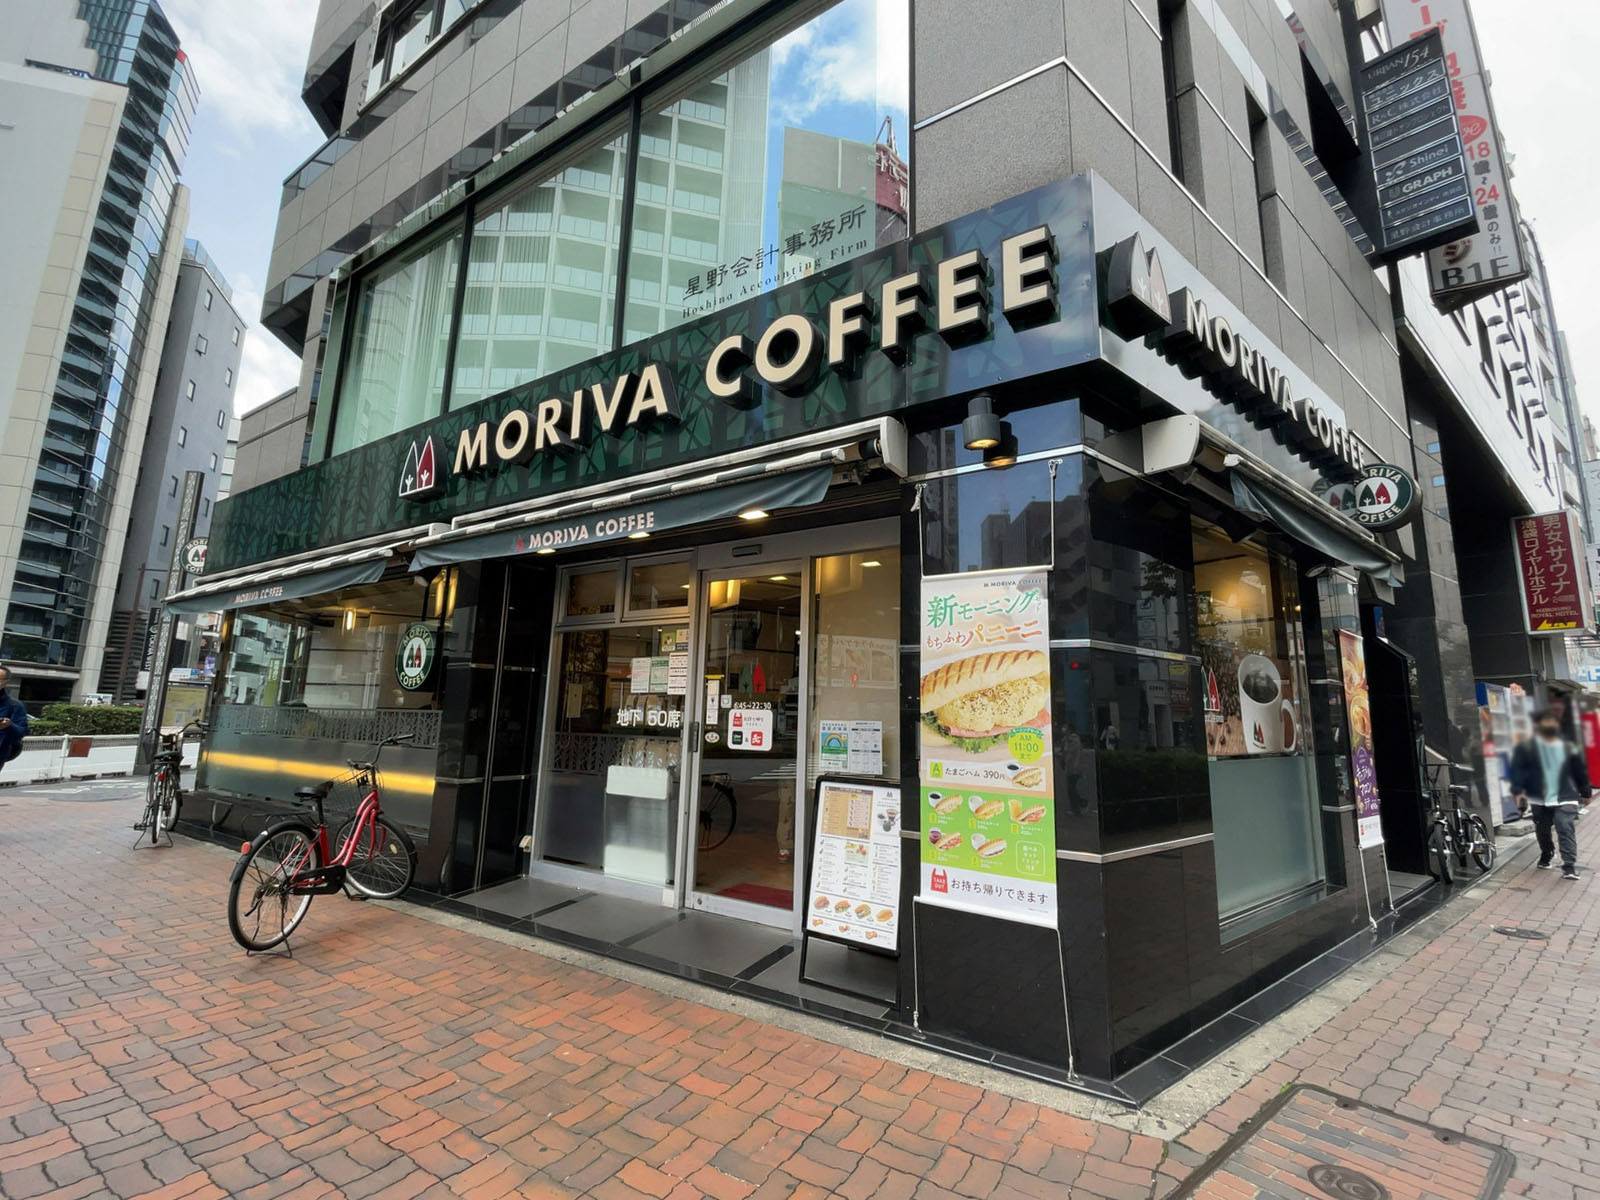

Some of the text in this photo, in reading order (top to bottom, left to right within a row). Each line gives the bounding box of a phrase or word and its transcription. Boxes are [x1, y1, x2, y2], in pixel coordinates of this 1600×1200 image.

[1403, 46, 1430, 69] 154
[1409, 144, 1449, 168] Shinei
[1402, 166, 1453, 194] GRAPH
[683, 204, 867, 300] 星野会計事務所
[682, 239, 868, 319] Hoshino Accounting Firm
[1440, 255, 1510, 290] B1F
[454, 226, 1050, 475] MORIVA COFFEE
[1185, 286, 1368, 477] MORIVA COFFEE
[1357, 505, 1401, 522] OFFEE
[528, 511, 655, 549] MORIVA COFFEE
[187, 538, 209, 550] MORI
[1542, 514, 1571, 595] 男女サウナ
[990, 580, 1017, 588] MORIVA
[927, 588, 1040, 629] 新モーニング
[403, 627, 431, 647] MORIVA
[400, 671, 425, 687] COFFEE
[616, 708, 642, 727] 地下
[1014, 742, 1039, 753] 11:00
[945, 767, 981, 778] たまごハム
[951, 879, 1049, 905] お持ち帰りできます
